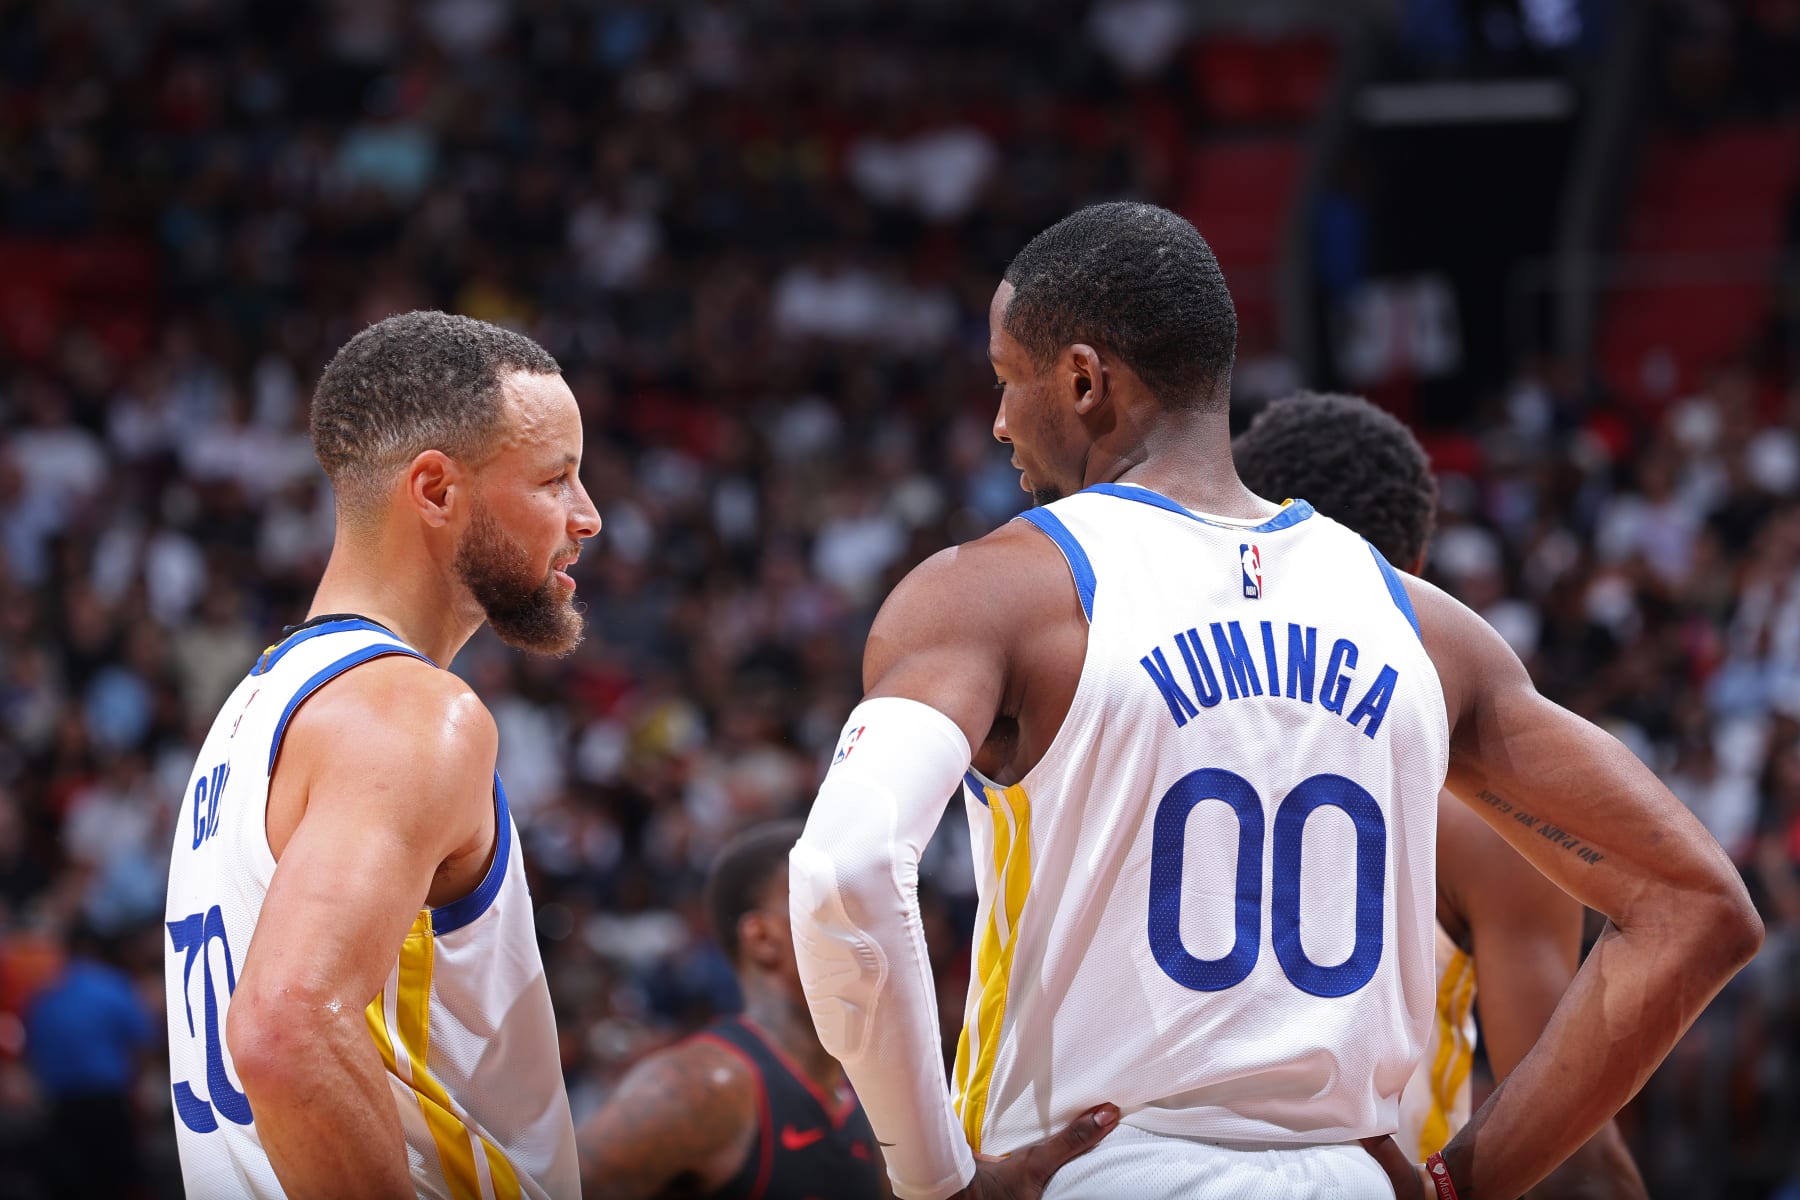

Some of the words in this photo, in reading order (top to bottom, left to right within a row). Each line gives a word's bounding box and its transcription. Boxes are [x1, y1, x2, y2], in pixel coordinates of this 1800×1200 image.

[1140, 621, 1398, 739] KUMINGA
[192, 760, 231, 851] CU
[1538, 824, 1578, 850] PAIN
[1148, 768, 1387, 997] 00
[1577, 848, 1604, 866] NO
